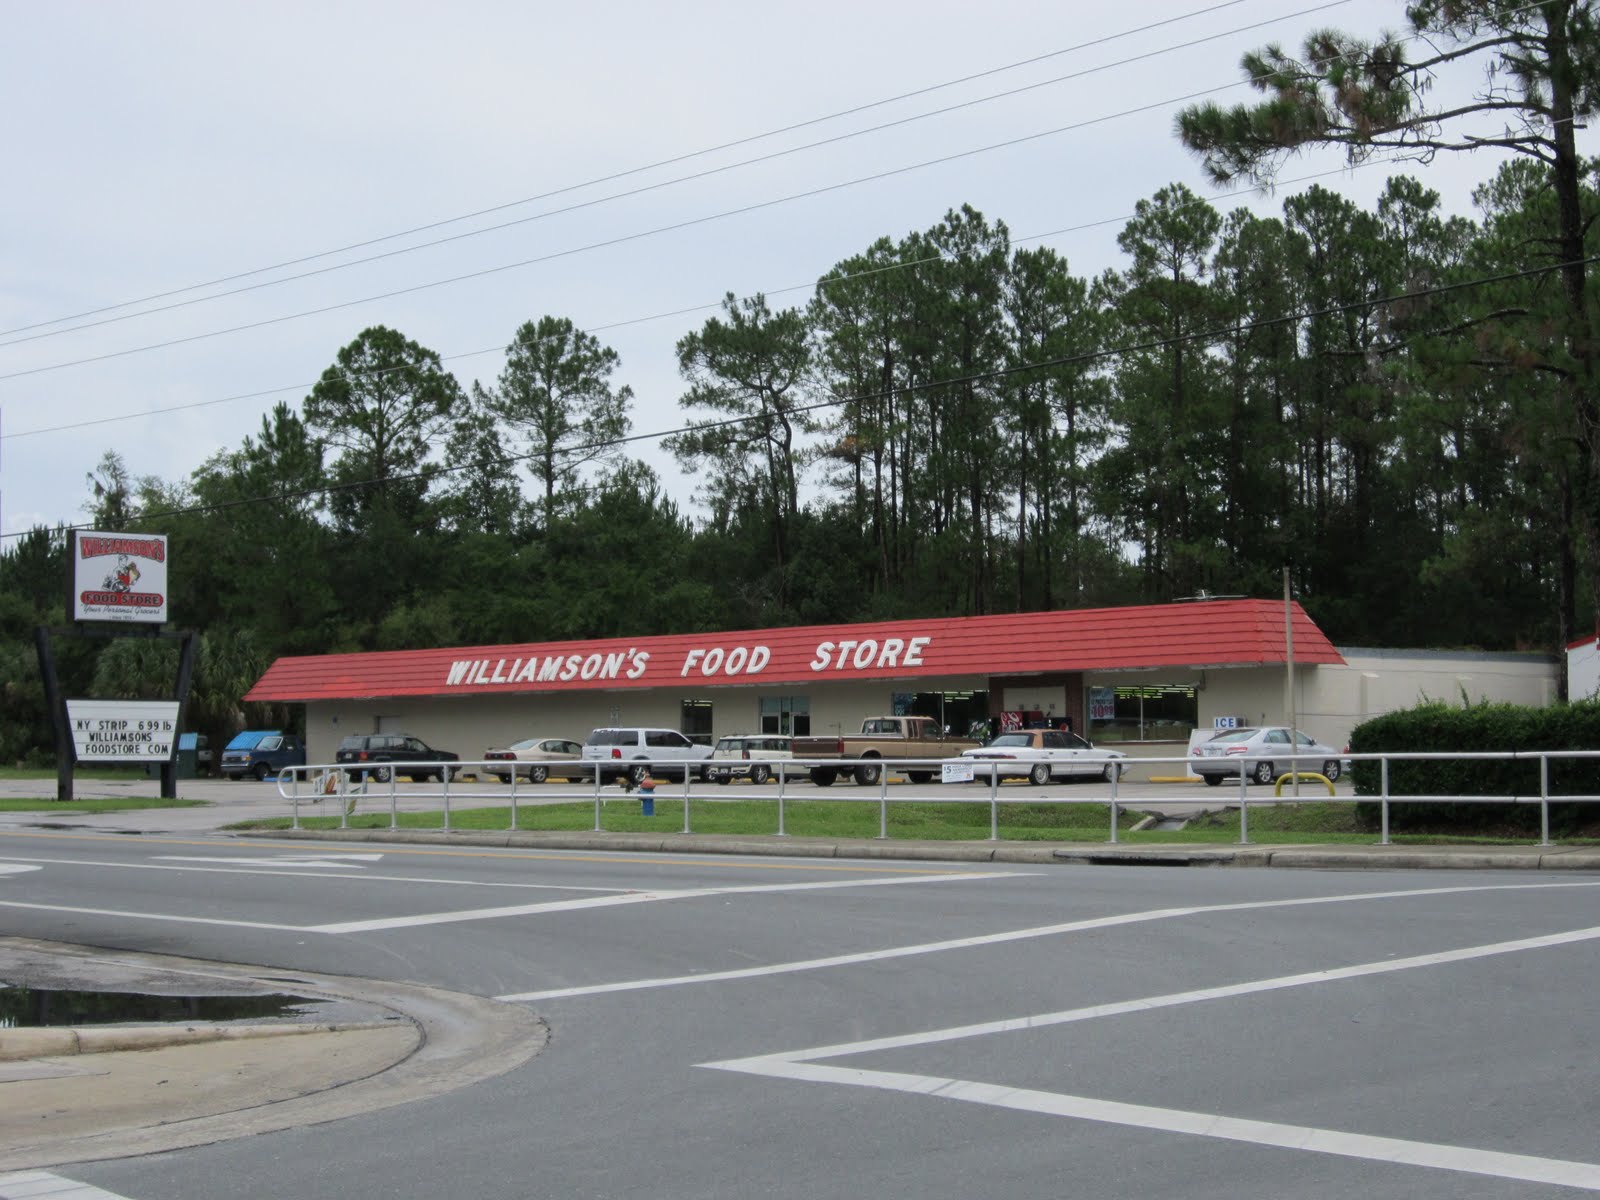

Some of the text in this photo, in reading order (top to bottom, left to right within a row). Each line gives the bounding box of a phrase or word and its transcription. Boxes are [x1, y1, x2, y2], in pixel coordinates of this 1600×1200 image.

[80, 537, 165, 563] WILLIAMSON'S
[86, 594, 159, 605] FOOD STORE
[445, 637, 931, 685] WILLIAMSON'S FOOD STORE
[77, 720, 90, 730] NY
[99, 720, 128, 730] STRIP
[1216, 717, 1234, 728] ICE
[89, 732, 152, 742] WILLIAMSONS
